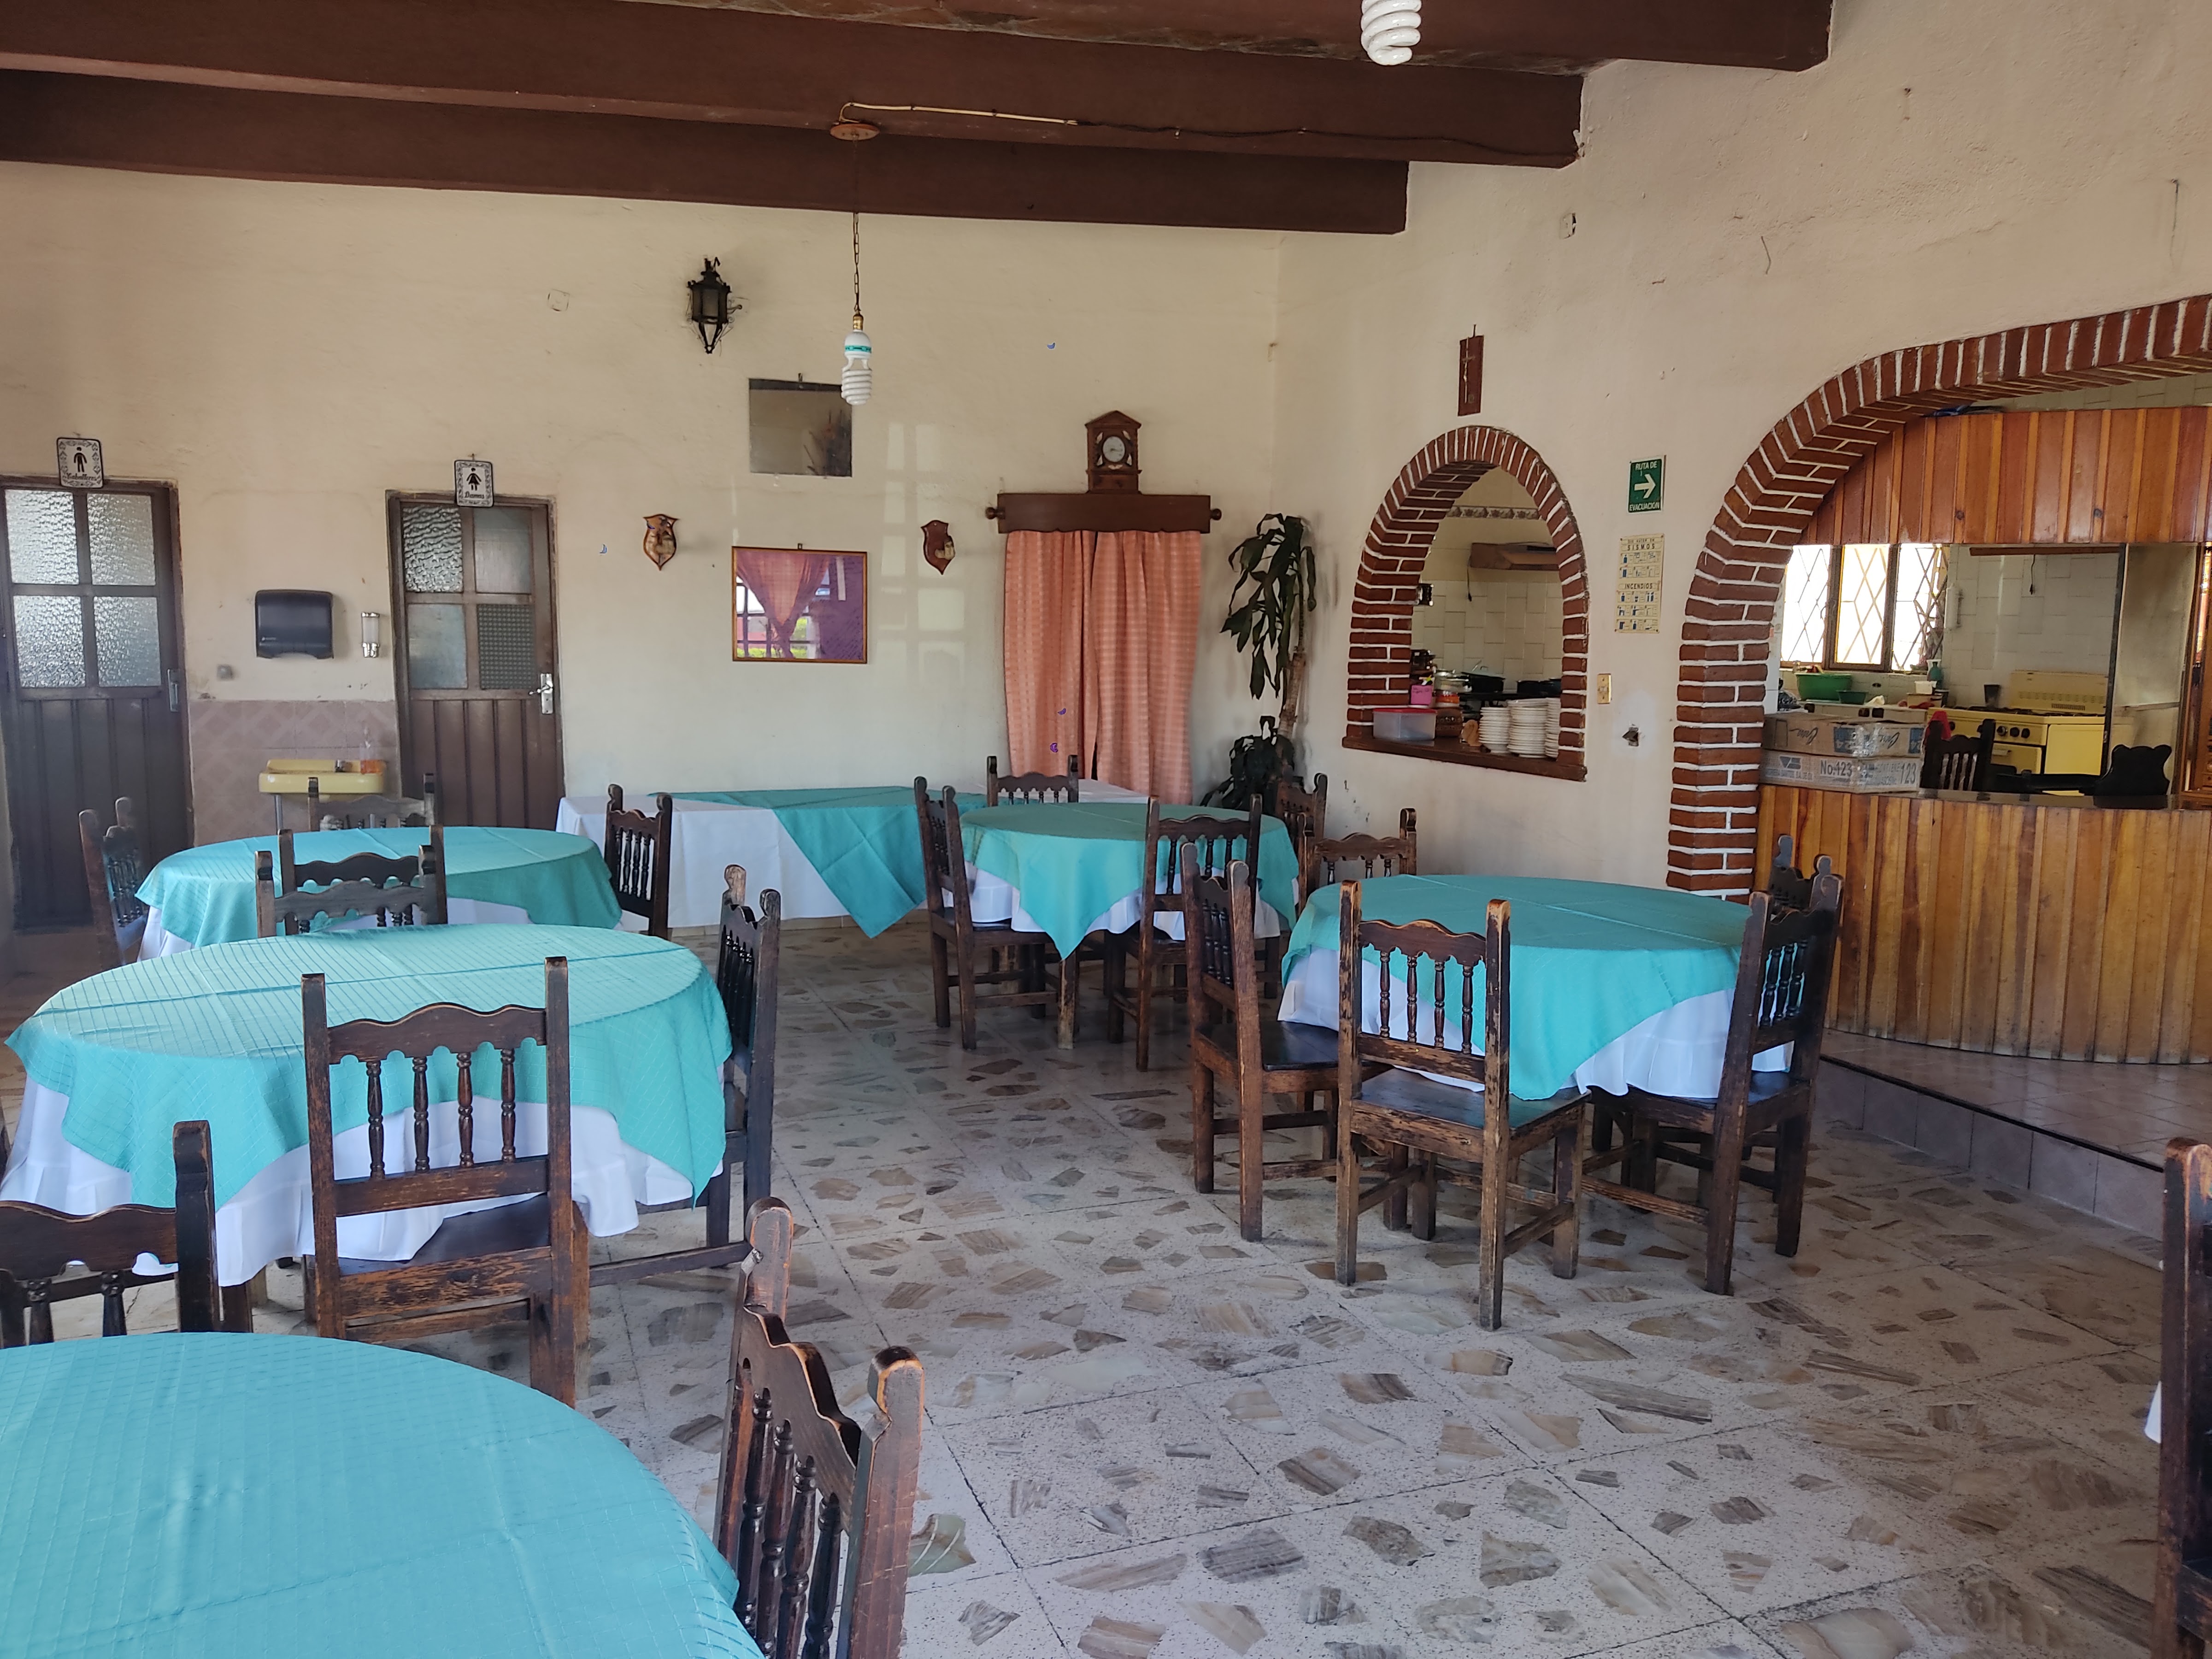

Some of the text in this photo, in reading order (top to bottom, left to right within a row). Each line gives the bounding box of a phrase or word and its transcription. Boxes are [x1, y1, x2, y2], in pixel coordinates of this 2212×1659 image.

[1635, 461, 1658, 471] RUTA DE
[465, 491, 485, 499] Damas
[1900, 763, 1917, 784] 123
